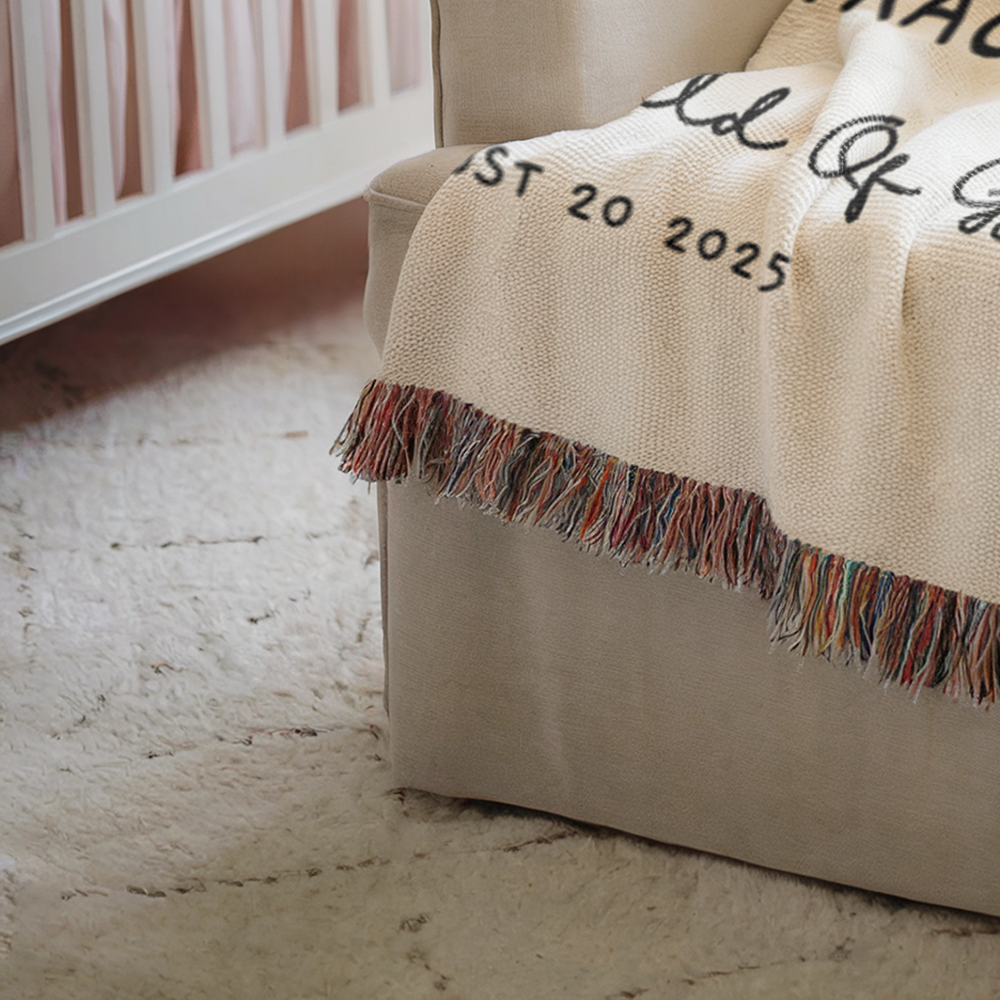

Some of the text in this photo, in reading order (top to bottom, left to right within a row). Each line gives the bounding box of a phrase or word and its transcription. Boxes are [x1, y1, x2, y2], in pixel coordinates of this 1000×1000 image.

[453, 145, 791, 292] ST 20 2025
[807, 114, 922, 223] Of
